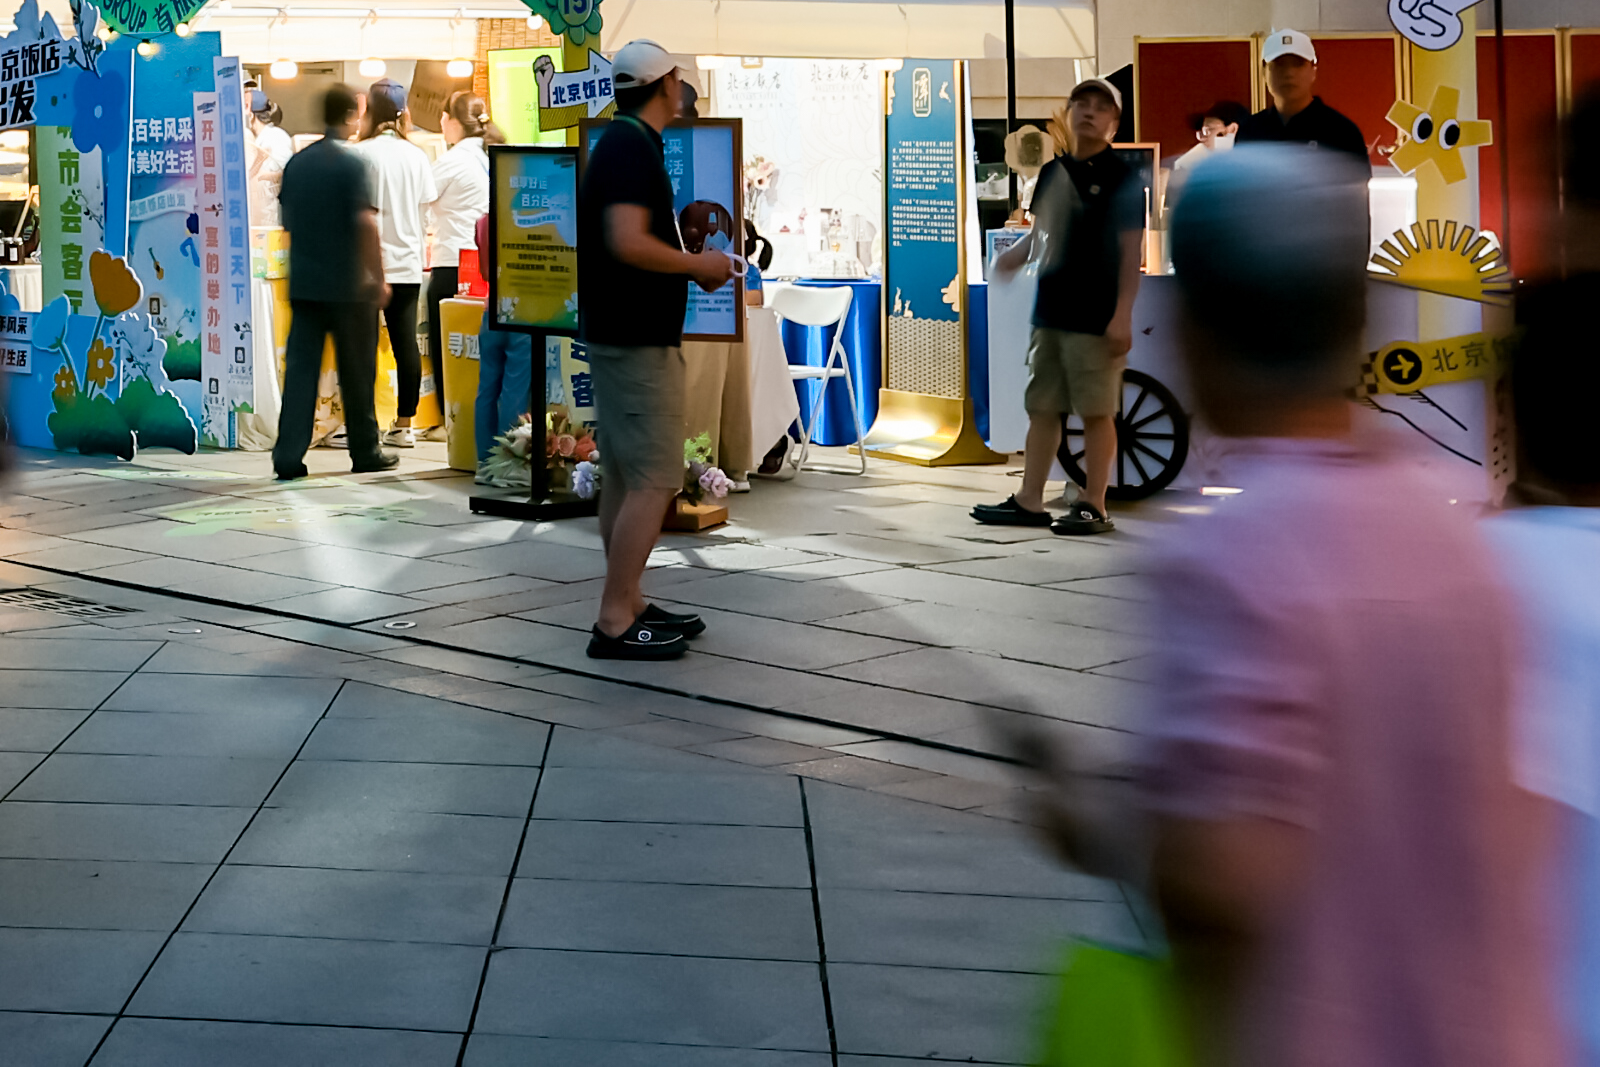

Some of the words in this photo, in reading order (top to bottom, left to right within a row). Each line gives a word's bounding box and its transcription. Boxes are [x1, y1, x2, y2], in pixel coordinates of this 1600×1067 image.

[552, 78, 612, 105] 北京饭店
[132, 117, 193, 142] 百年风采
